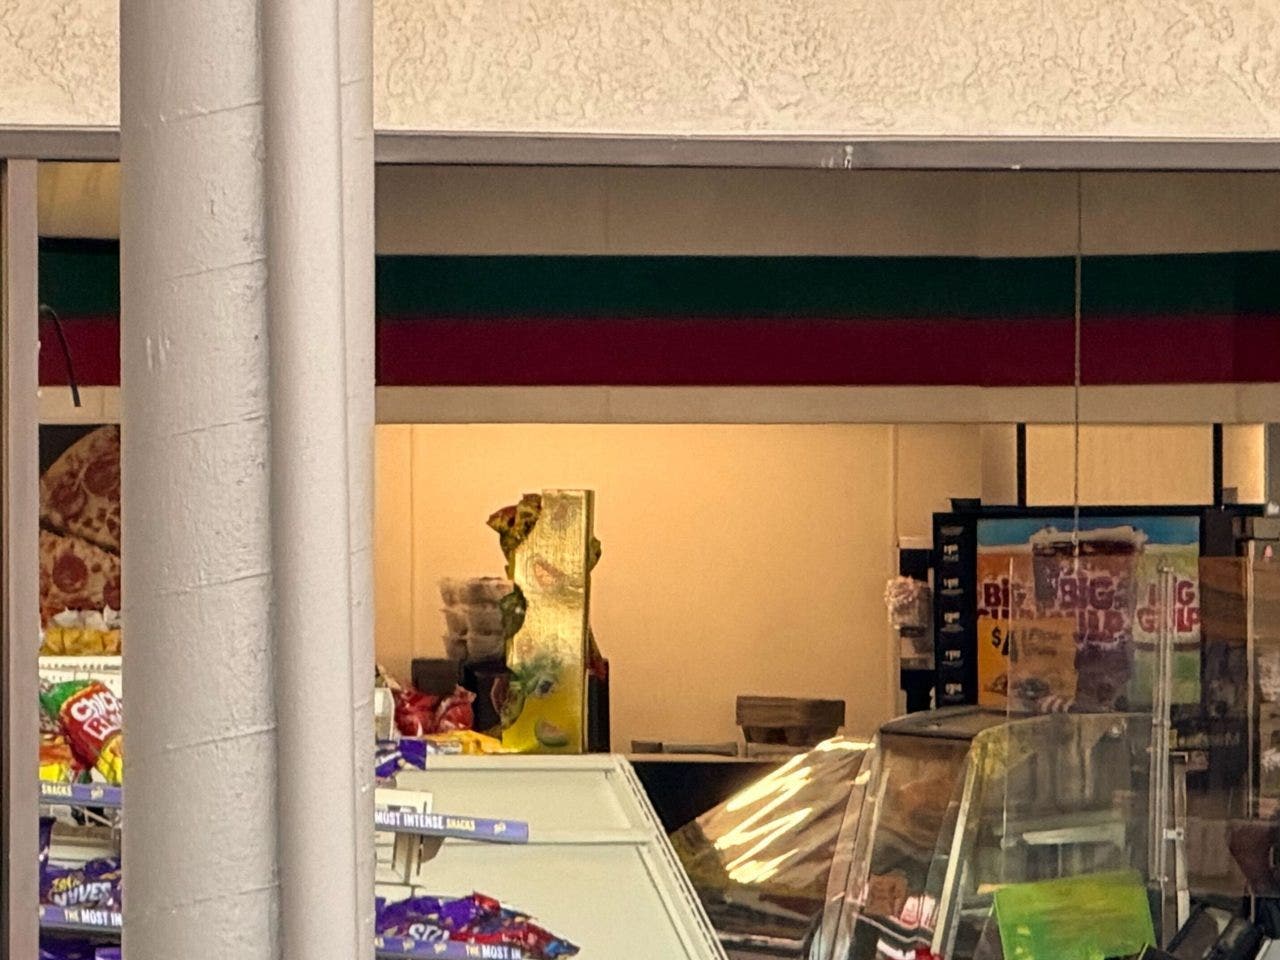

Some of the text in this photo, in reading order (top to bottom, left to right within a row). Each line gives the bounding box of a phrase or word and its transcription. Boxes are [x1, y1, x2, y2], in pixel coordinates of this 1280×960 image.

[81, 908, 108, 926] MOST
[110, 912, 122, 926] IN
[481, 944, 508, 959] MOST
